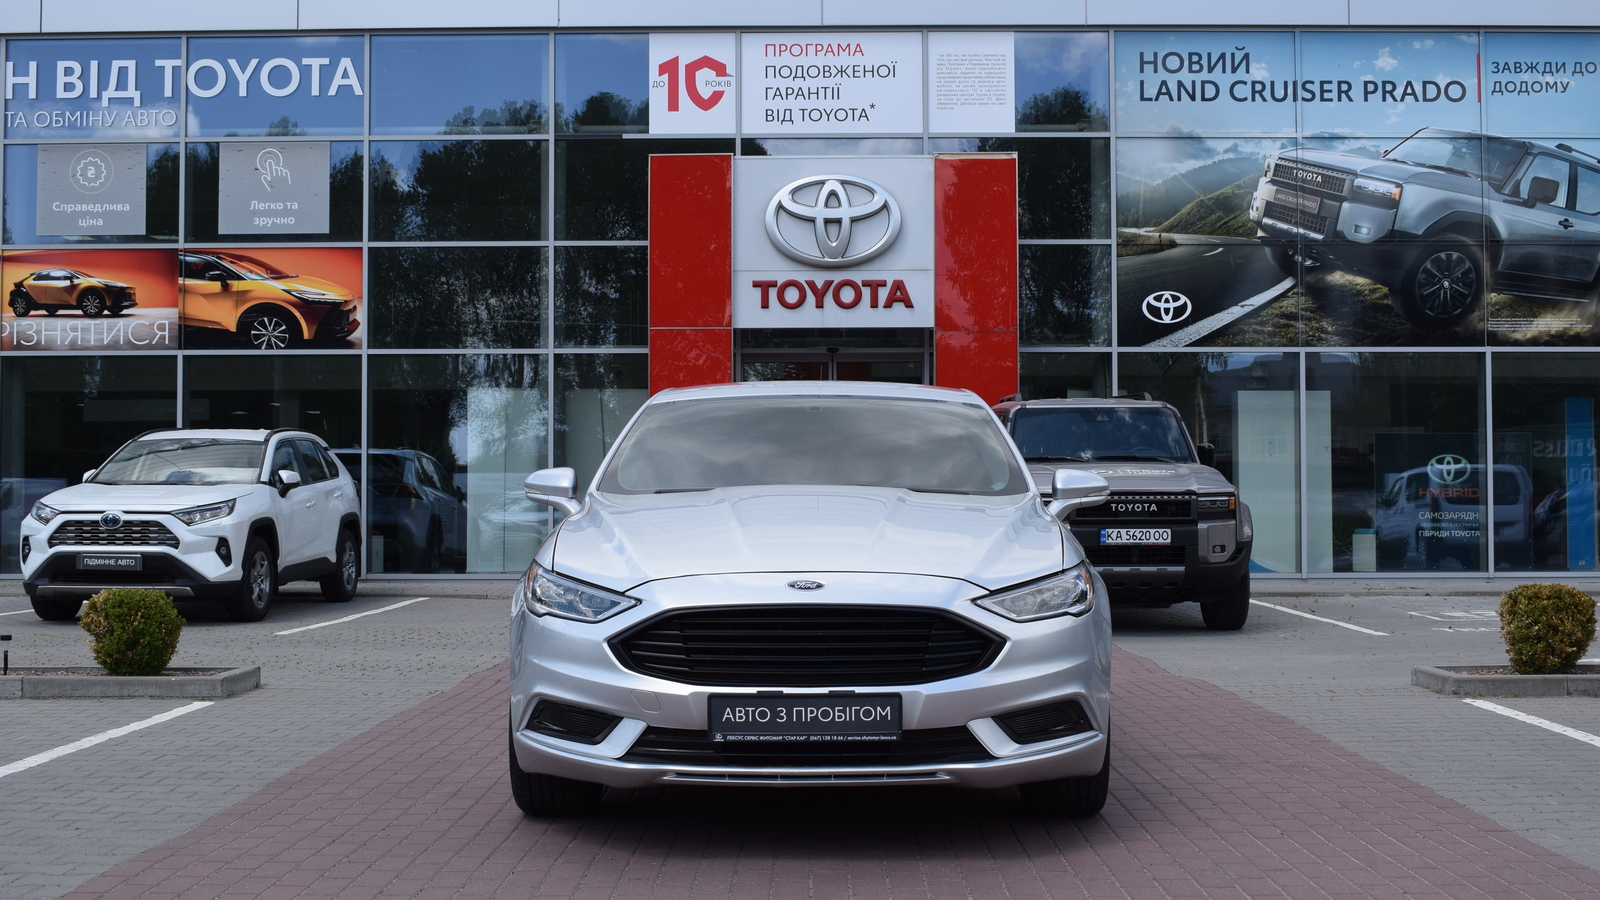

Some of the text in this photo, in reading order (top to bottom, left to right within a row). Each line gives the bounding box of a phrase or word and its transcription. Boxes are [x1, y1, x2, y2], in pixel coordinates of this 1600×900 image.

[765, 43, 864, 57] ПРОГРАМА
[1139, 46, 1251, 74] НОВИЙ
[765, 61, 897, 81] ПОДОВЖЕНОЇ
[1491, 61, 1600, 77] ЗАВЖДИ ДО
[56, 60, 141, 107] ВІД
[155, 57, 364, 98] TOYOTA
[652, 80, 665, 89] ДО
[658, 55, 727, 112] 10
[1491, 81, 1570, 96] ДОДОМУ
[765, 83, 842, 100] ГАРАНТІЇ
[1139, 79, 1467, 103] LAND CRUISER PRADO
[5, 109, 177, 127] ТА ОБМІНУ АВТО
[765, 108, 794, 125] ВІД
[1293, 170, 1322, 182] TOYOTA
[52, 201, 130, 215] Справедлива
[250, 200, 299, 212] Легко та
[78, 215, 103, 227] ціна
[252, 215, 295, 227] зручно
[752, 279, 914, 309] TOYOTA
[1418, 488, 1481, 498] HYBRID
[1110, 503, 1158, 512] TOYOTA
[1125, 530, 1151, 541] 5620
[1418, 530, 1450, 538] ГІБРИДИ
[84, 558, 116, 566] ПІДМІННЕ
[794, 581, 818, 589] Ford
[722, 706, 891, 722] АВТО З ПРОБІГОМ
